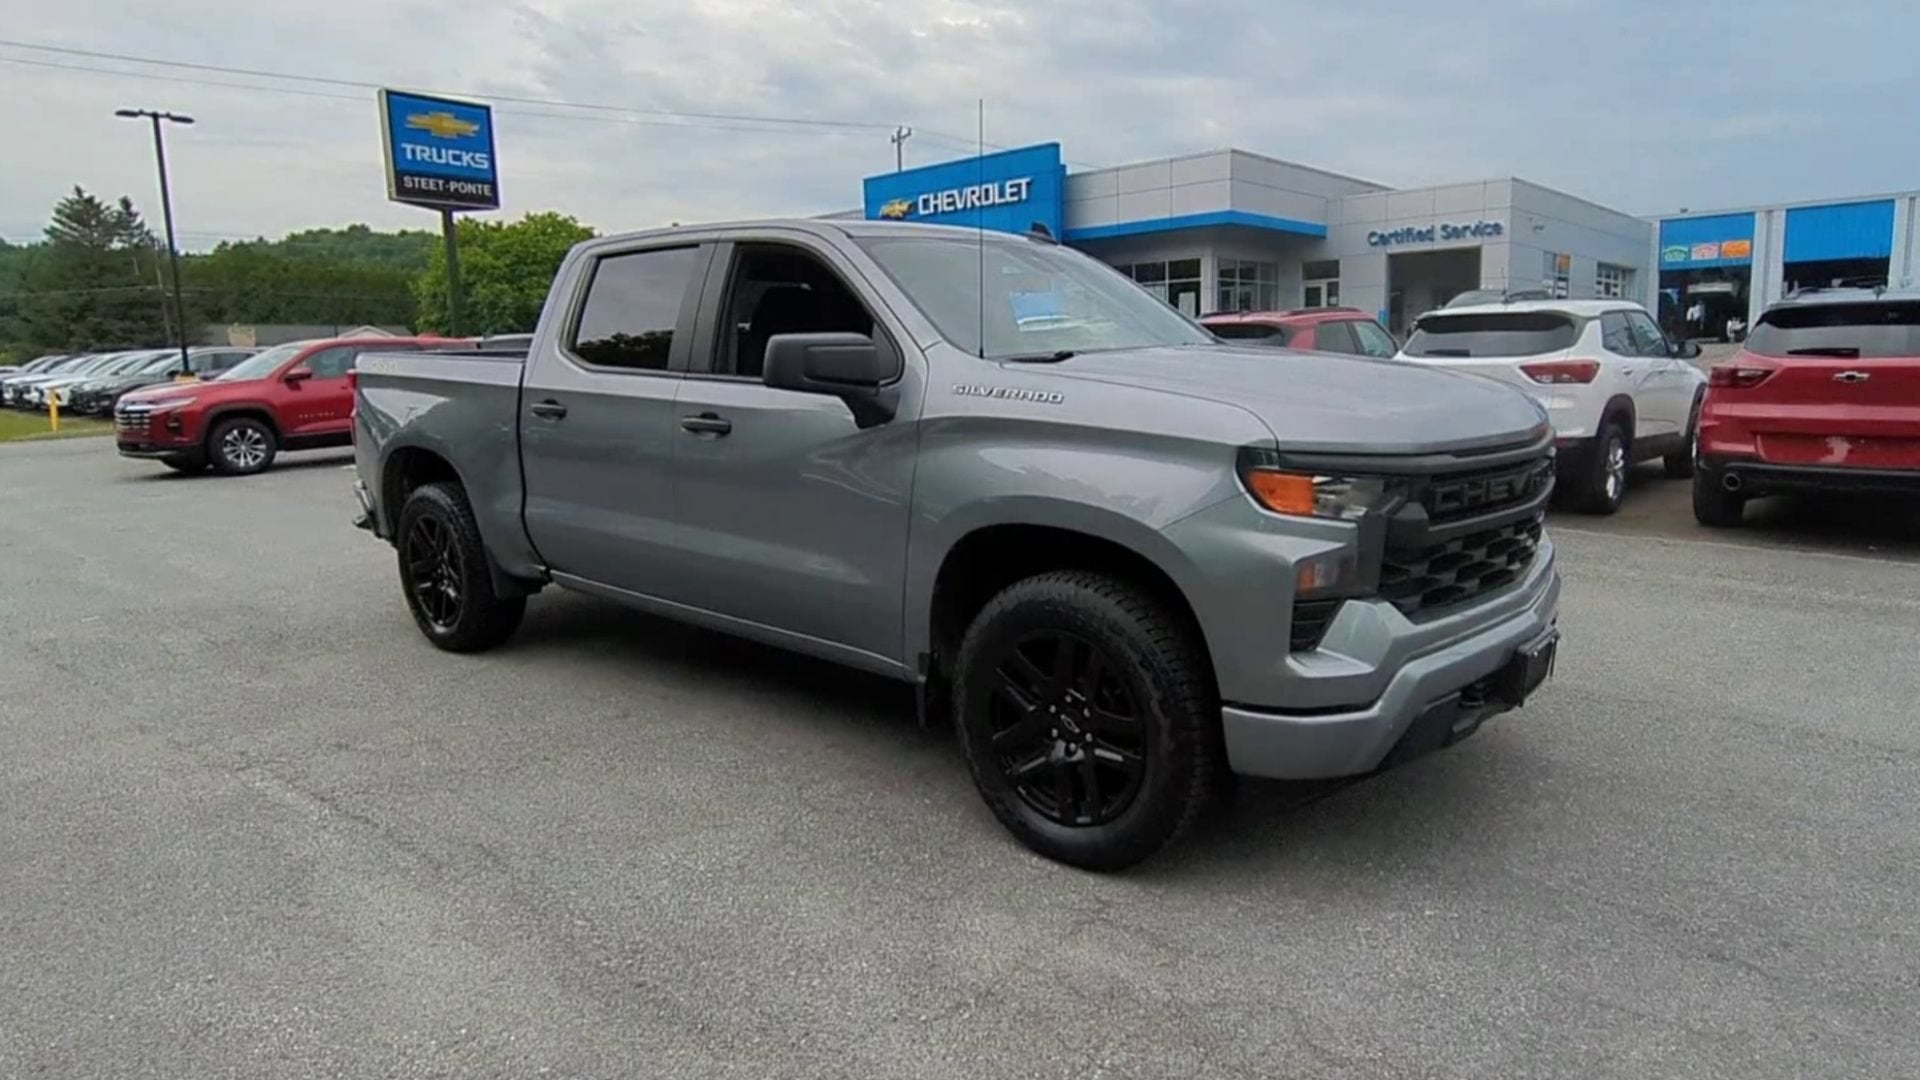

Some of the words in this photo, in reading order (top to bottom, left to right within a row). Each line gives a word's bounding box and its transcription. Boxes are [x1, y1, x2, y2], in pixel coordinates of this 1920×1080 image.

[401, 143, 489, 169] TRUCKS
[403, 175, 493, 196] STEET-PONTE
[918, 177, 1032, 215] CHEVROLET
[1367, 225, 1435, 246] Certified
[1440, 220, 1503, 240] Service
[952, 384, 1064, 405] SILVERADO
